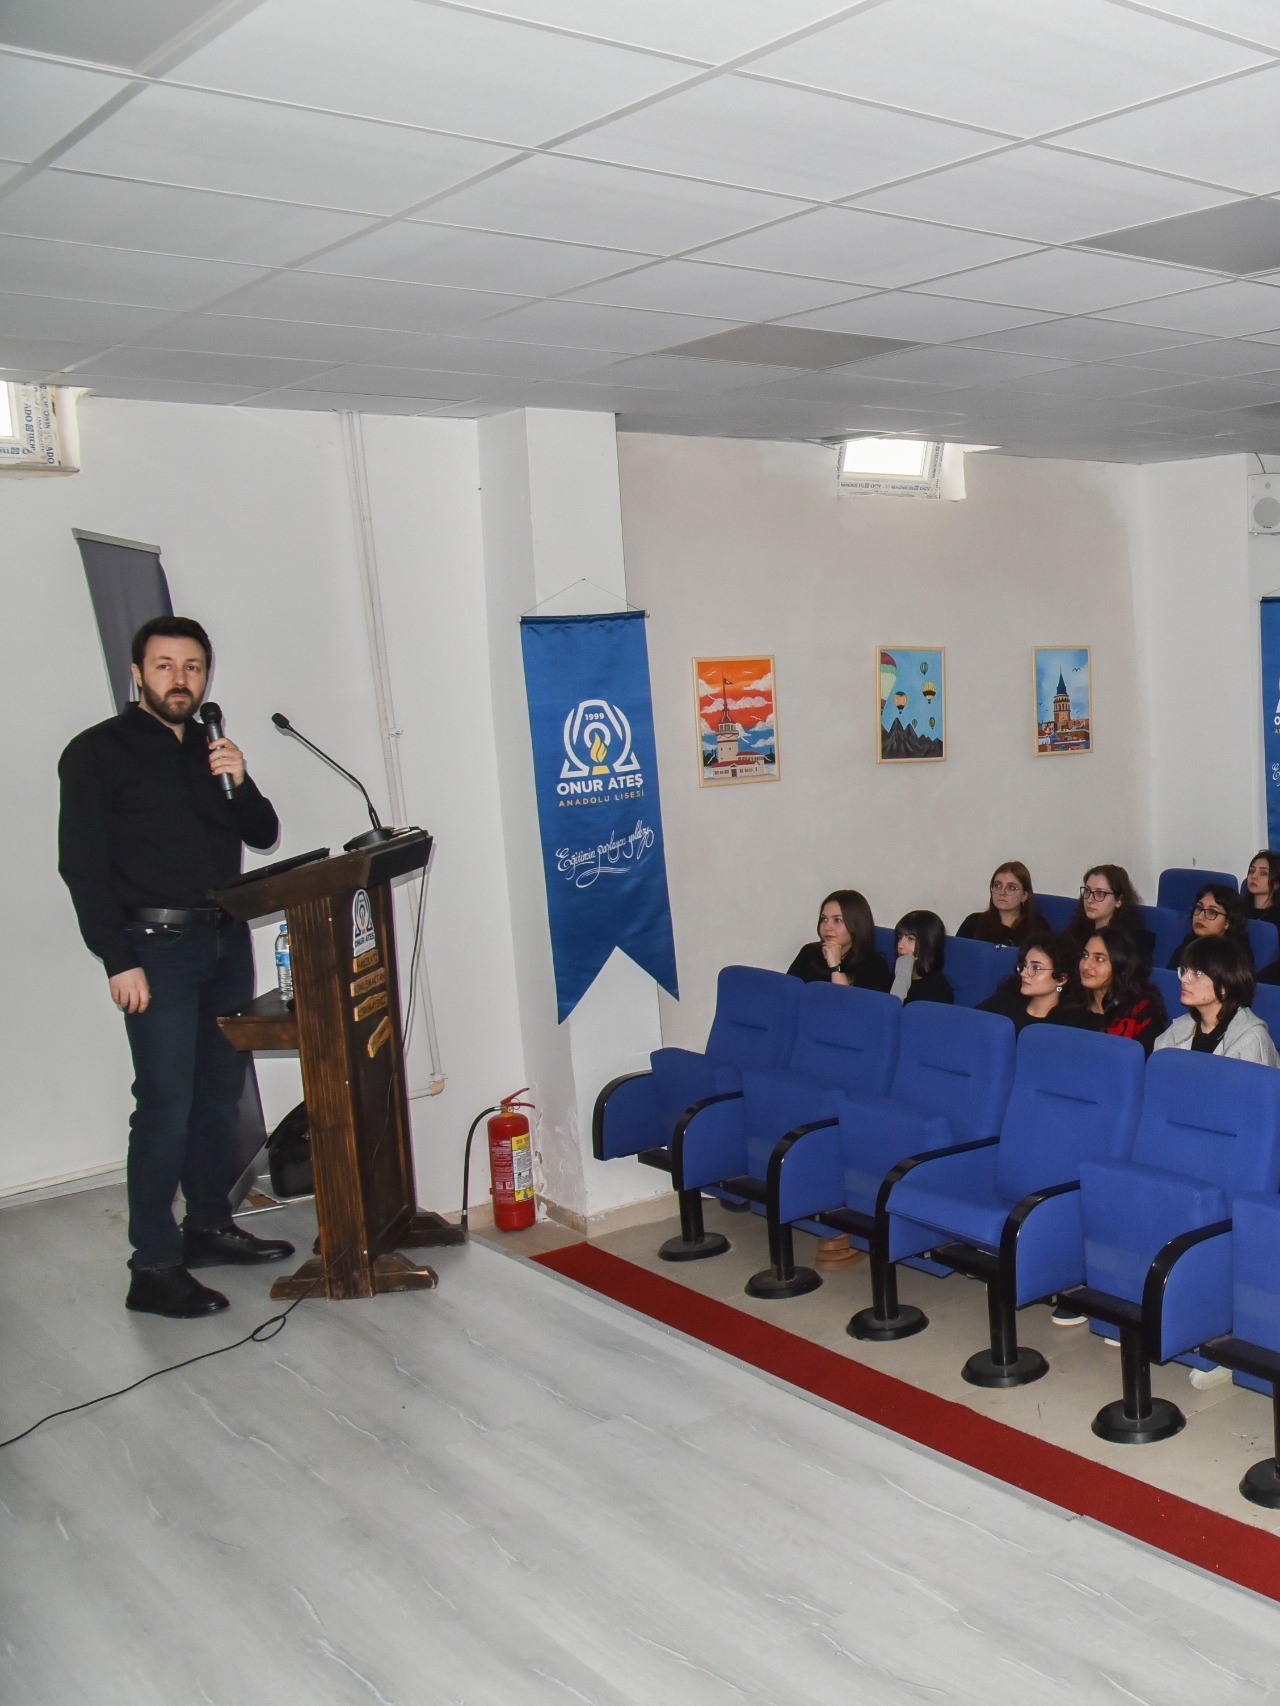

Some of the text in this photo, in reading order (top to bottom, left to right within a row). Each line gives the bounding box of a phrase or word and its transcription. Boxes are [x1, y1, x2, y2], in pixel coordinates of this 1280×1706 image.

[584, 712, 605, 721] 1999
[556, 773, 644, 795] ONUR ATEŞ
[559, 795, 610, 806] ANADOLU
